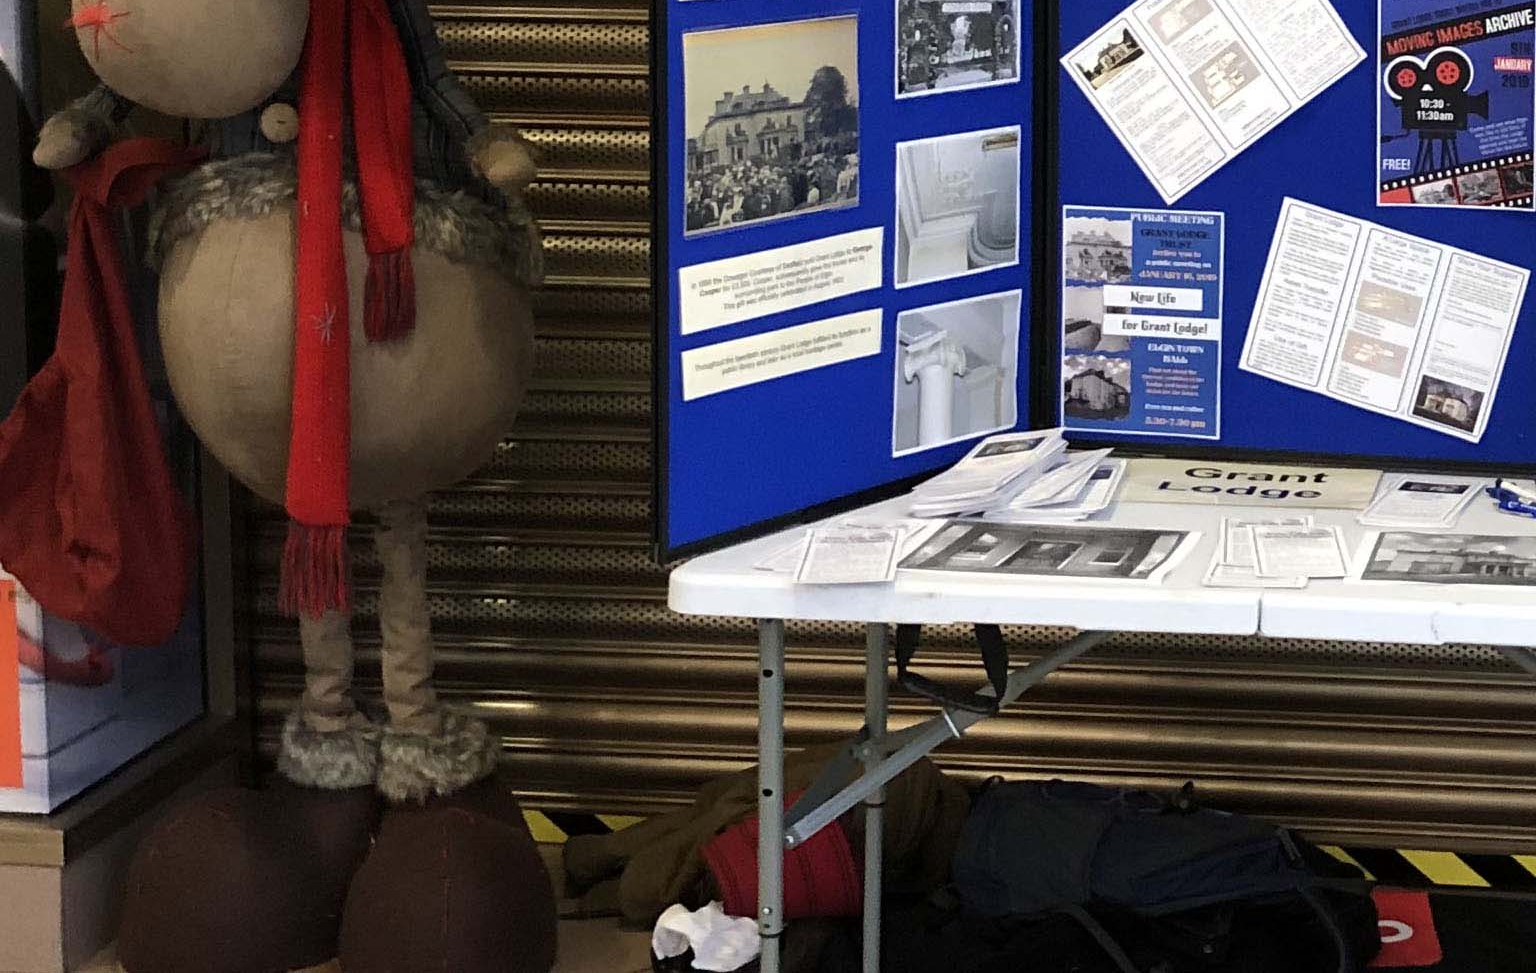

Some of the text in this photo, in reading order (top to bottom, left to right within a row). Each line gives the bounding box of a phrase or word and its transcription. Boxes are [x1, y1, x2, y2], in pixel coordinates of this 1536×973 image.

[1386, 9, 1534, 56] MOVING IMAGES ARCHIVE
[1420, 99, 1444, 109] 10:30
[1416, 111, 1454, 121] 11:30am
[1382, 158, 1411, 171] FREE!
[1130, 291, 1177, 305] New Life
[1122, 320, 1138, 330] for
[1141, 320, 1171, 332] Grant
[1185, 467, 1328, 483] Grant
[1158, 481, 1322, 498] Lodge
